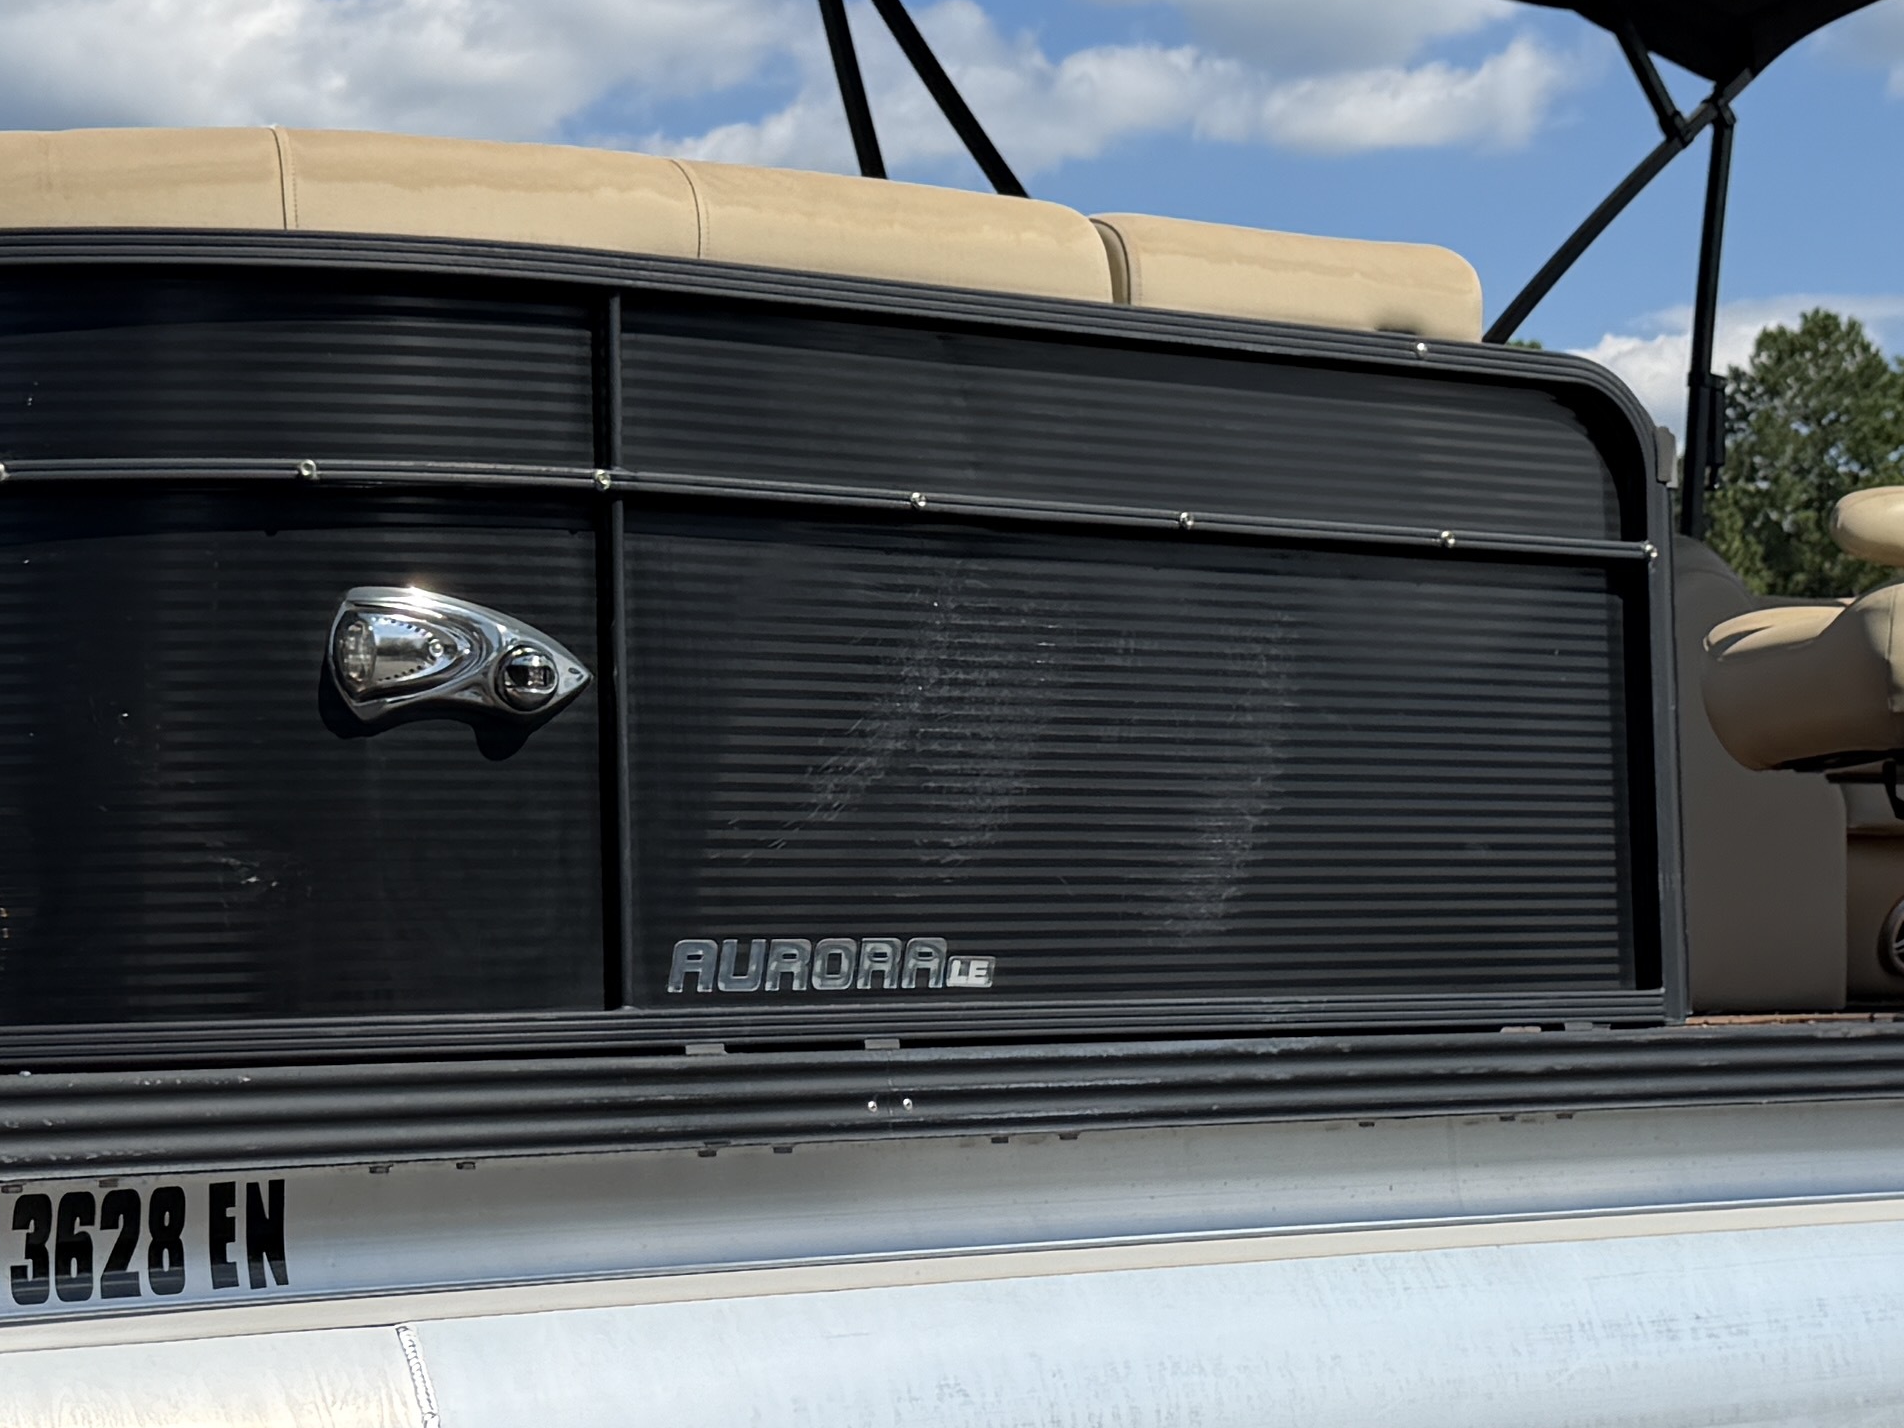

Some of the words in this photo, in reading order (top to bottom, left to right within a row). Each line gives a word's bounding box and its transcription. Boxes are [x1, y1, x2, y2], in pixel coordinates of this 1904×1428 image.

[666, 937, 947, 993] AURORA
[949, 957, 993, 986] LE
[10, 1186, 187, 1305] 3628
[208, 1179, 290, 1291] EN
